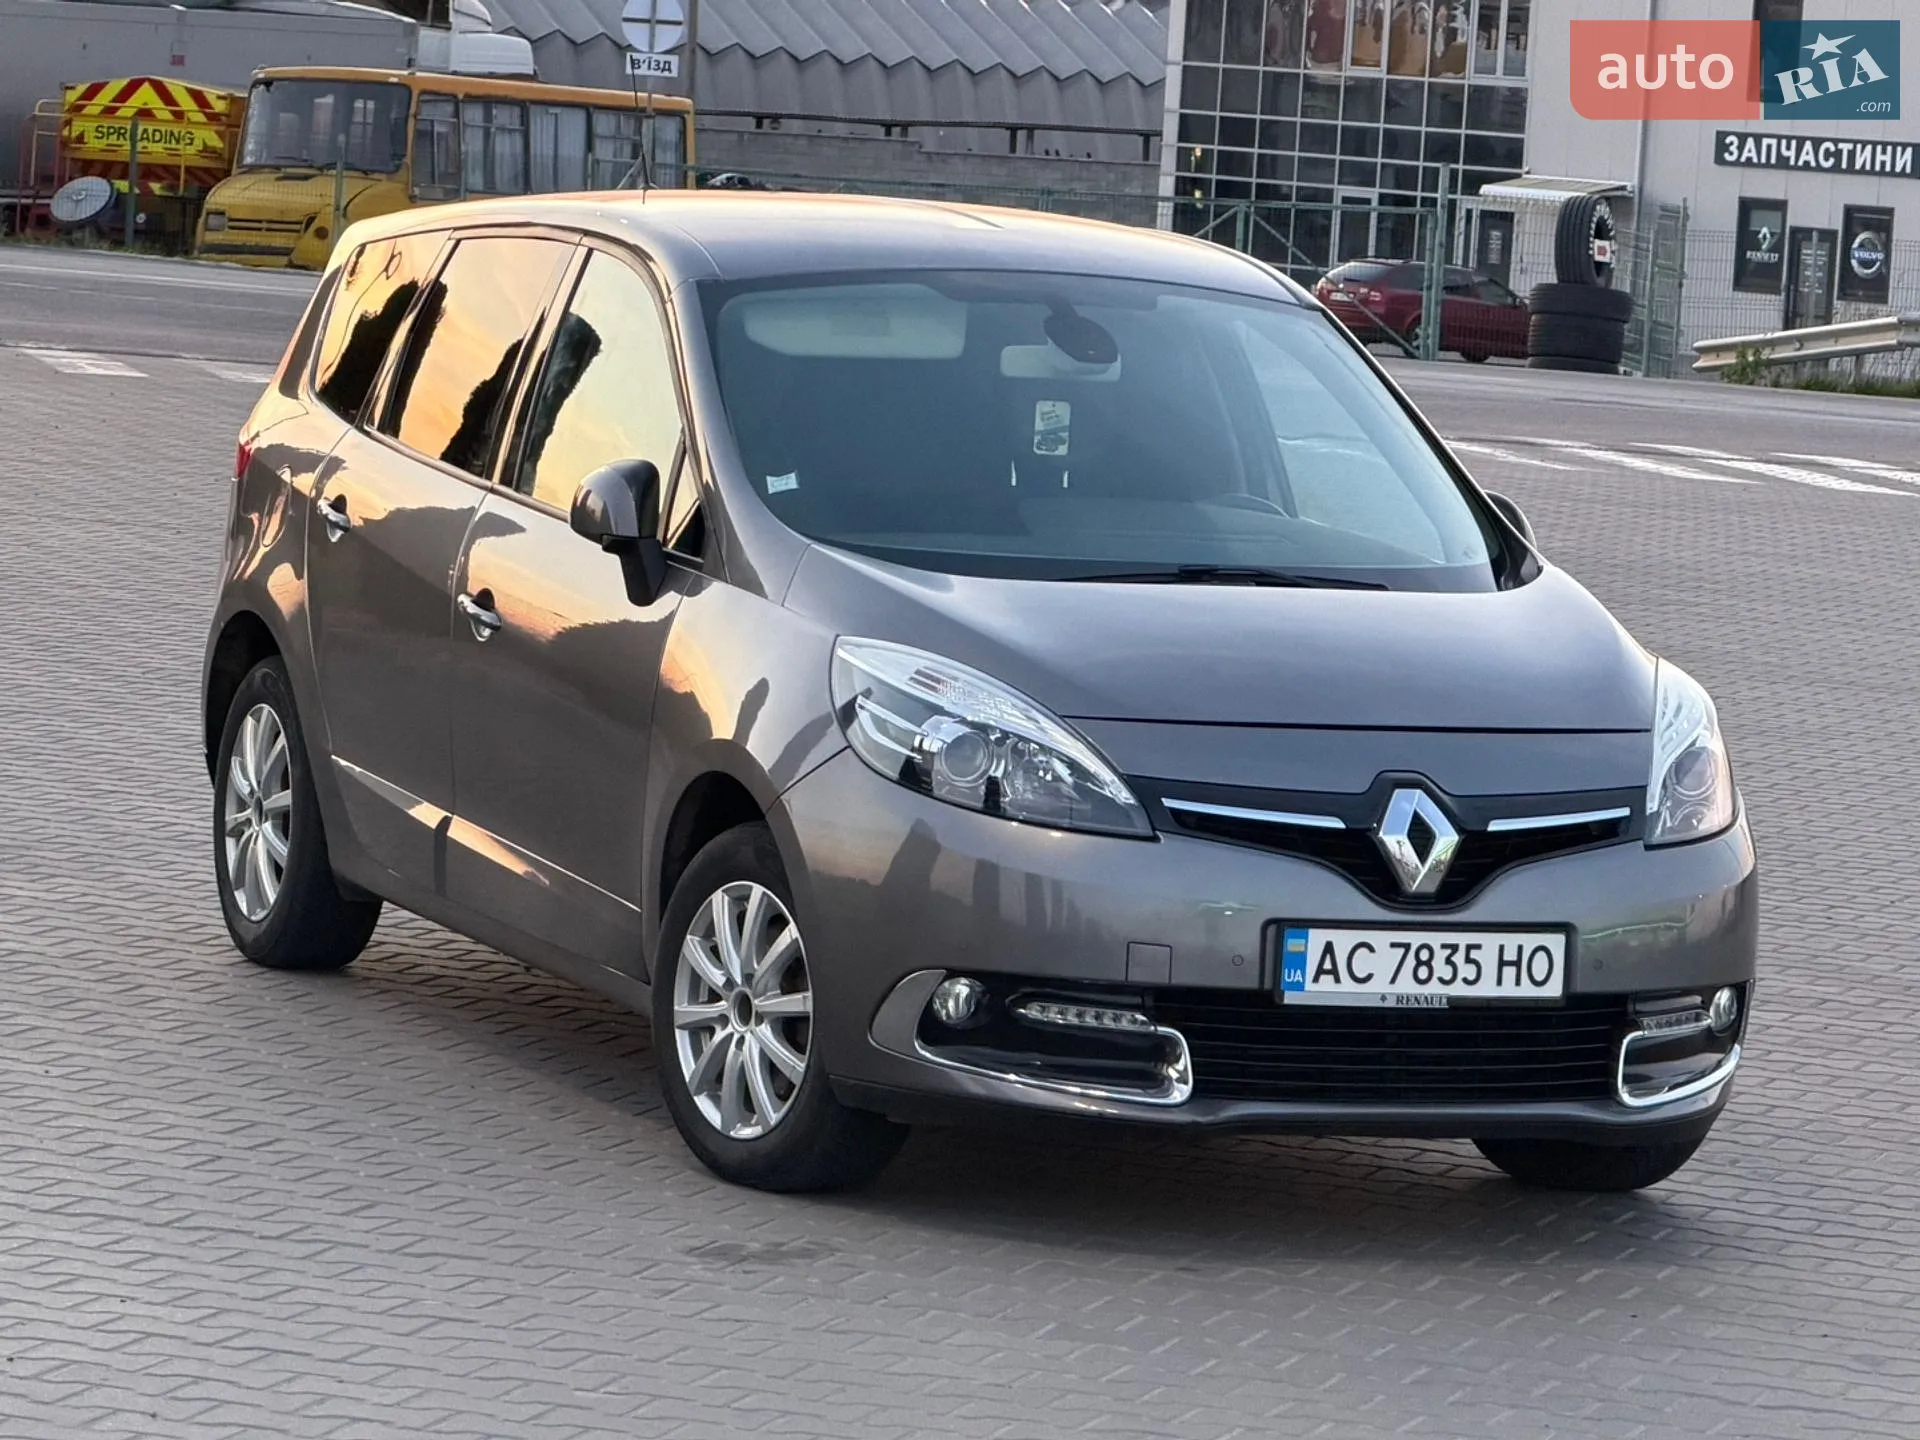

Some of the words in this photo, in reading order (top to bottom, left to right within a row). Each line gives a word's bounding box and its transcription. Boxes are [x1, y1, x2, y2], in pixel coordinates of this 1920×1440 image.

[94, 125, 196, 146] SPRADING
[1723, 134, 1914, 174] ЗАПЧАСТИНИ
[1284, 968, 1304, 983] UA
[1311, 940, 1377, 985] AC
[1388, 942, 1484, 986] 7835
[1495, 943, 1555, 988] HO
